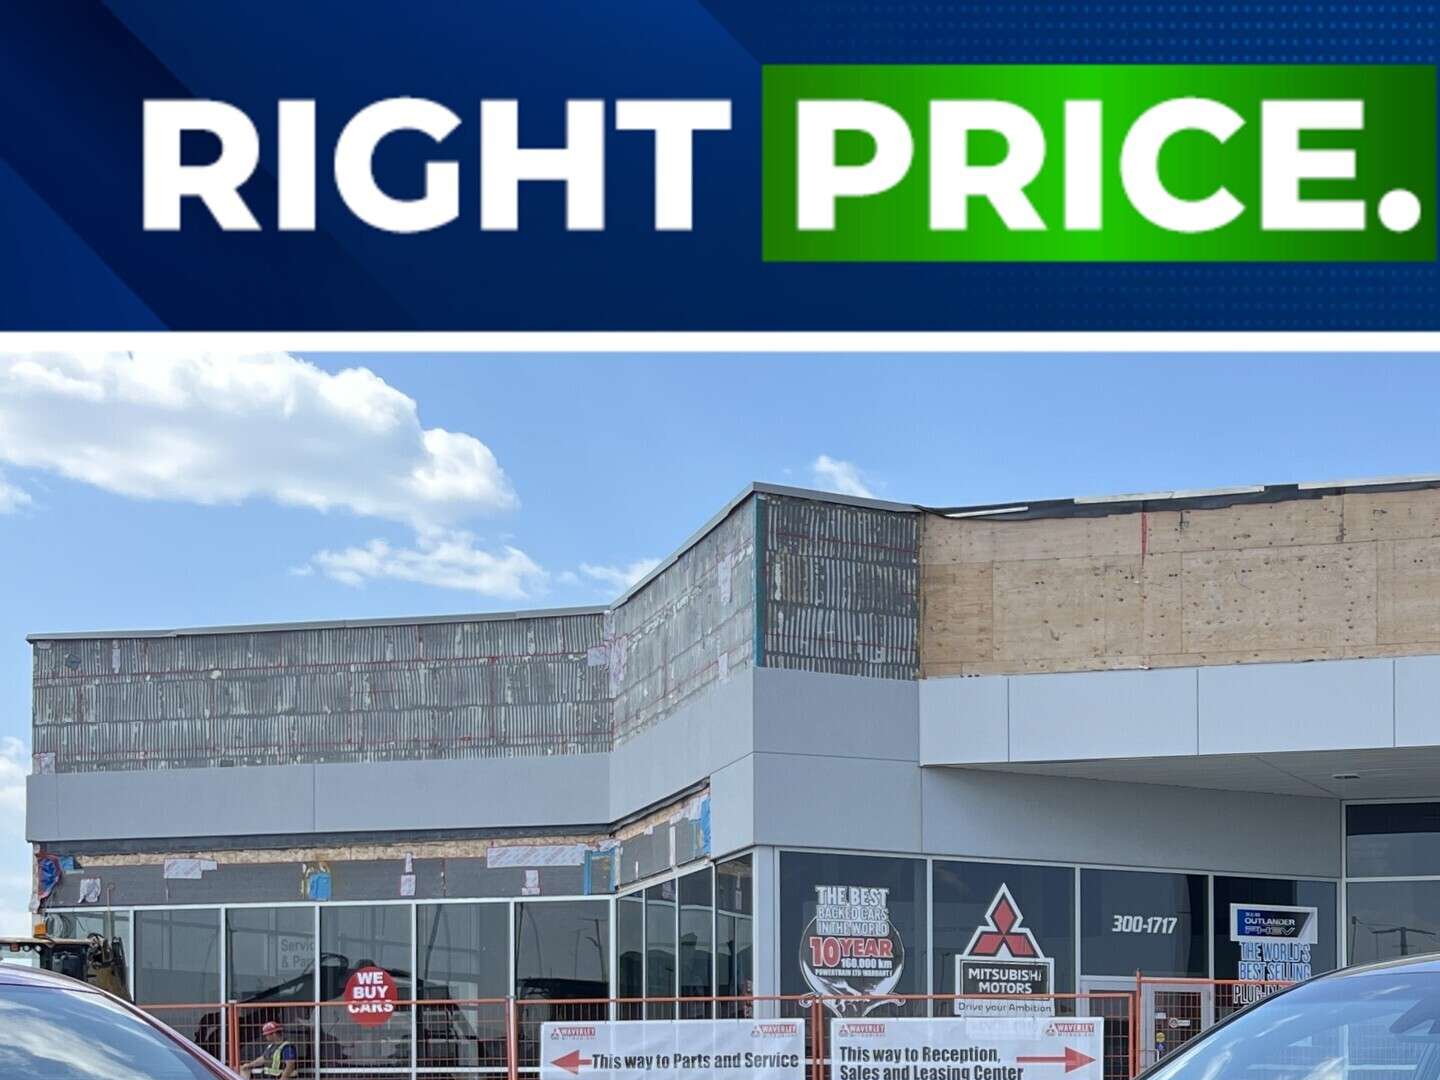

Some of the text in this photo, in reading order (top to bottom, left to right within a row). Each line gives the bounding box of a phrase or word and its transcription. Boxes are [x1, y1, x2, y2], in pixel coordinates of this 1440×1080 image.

[815, 885, 889, 906] THE BEST
[817, 905, 889, 920] BACKED CARS
[817, 920, 889, 936] IN THE WORLD
[1112, 915, 1178, 934] 300-1717
[1244, 917, 1296, 926] OUTLANDER
[810, 936, 894, 967] 10 YEAR
[1240, 941, 1311, 962] THE WORLD'S
[878, 958, 892, 969] km
[1239, 961, 1312, 981] BEST SELLING
[357, 971, 384, 985] WE
[968, 968, 1042, 981] MITSUBISHI
[352, 986, 389, 999] BUY
[979, 982, 1032, 994] MOTORS
[958, 1002, 1052, 1013] Drive your Ambition
[592, 1052, 800, 1071] This way to Parts and Service
[840, 1047, 1001, 1064] This way to Reception,
[840, 1065, 880, 1080] Sales
[883, 1065, 909, 1080] and
[974, 1066, 1024, 1080] Center
